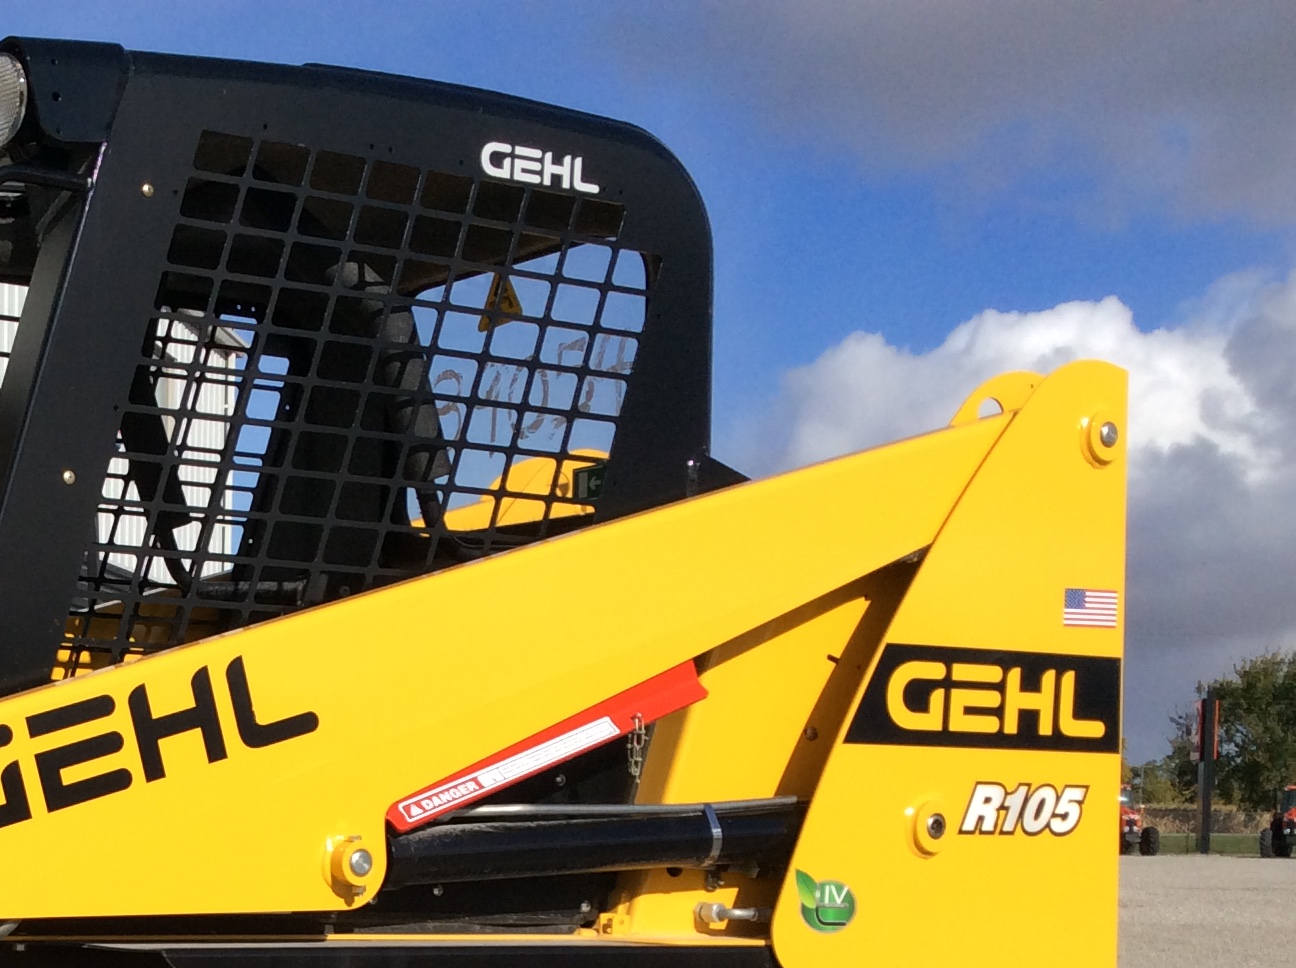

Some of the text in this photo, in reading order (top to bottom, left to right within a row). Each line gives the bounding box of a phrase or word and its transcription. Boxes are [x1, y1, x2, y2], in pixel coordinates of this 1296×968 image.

[480, 141, 600, 194] GEHL
[885, 660, 1106, 738] GEHL
[420, 780, 480, 811] DANGER
[957, 781, 1091, 837] R105
[824, 885, 849, 905] IV
